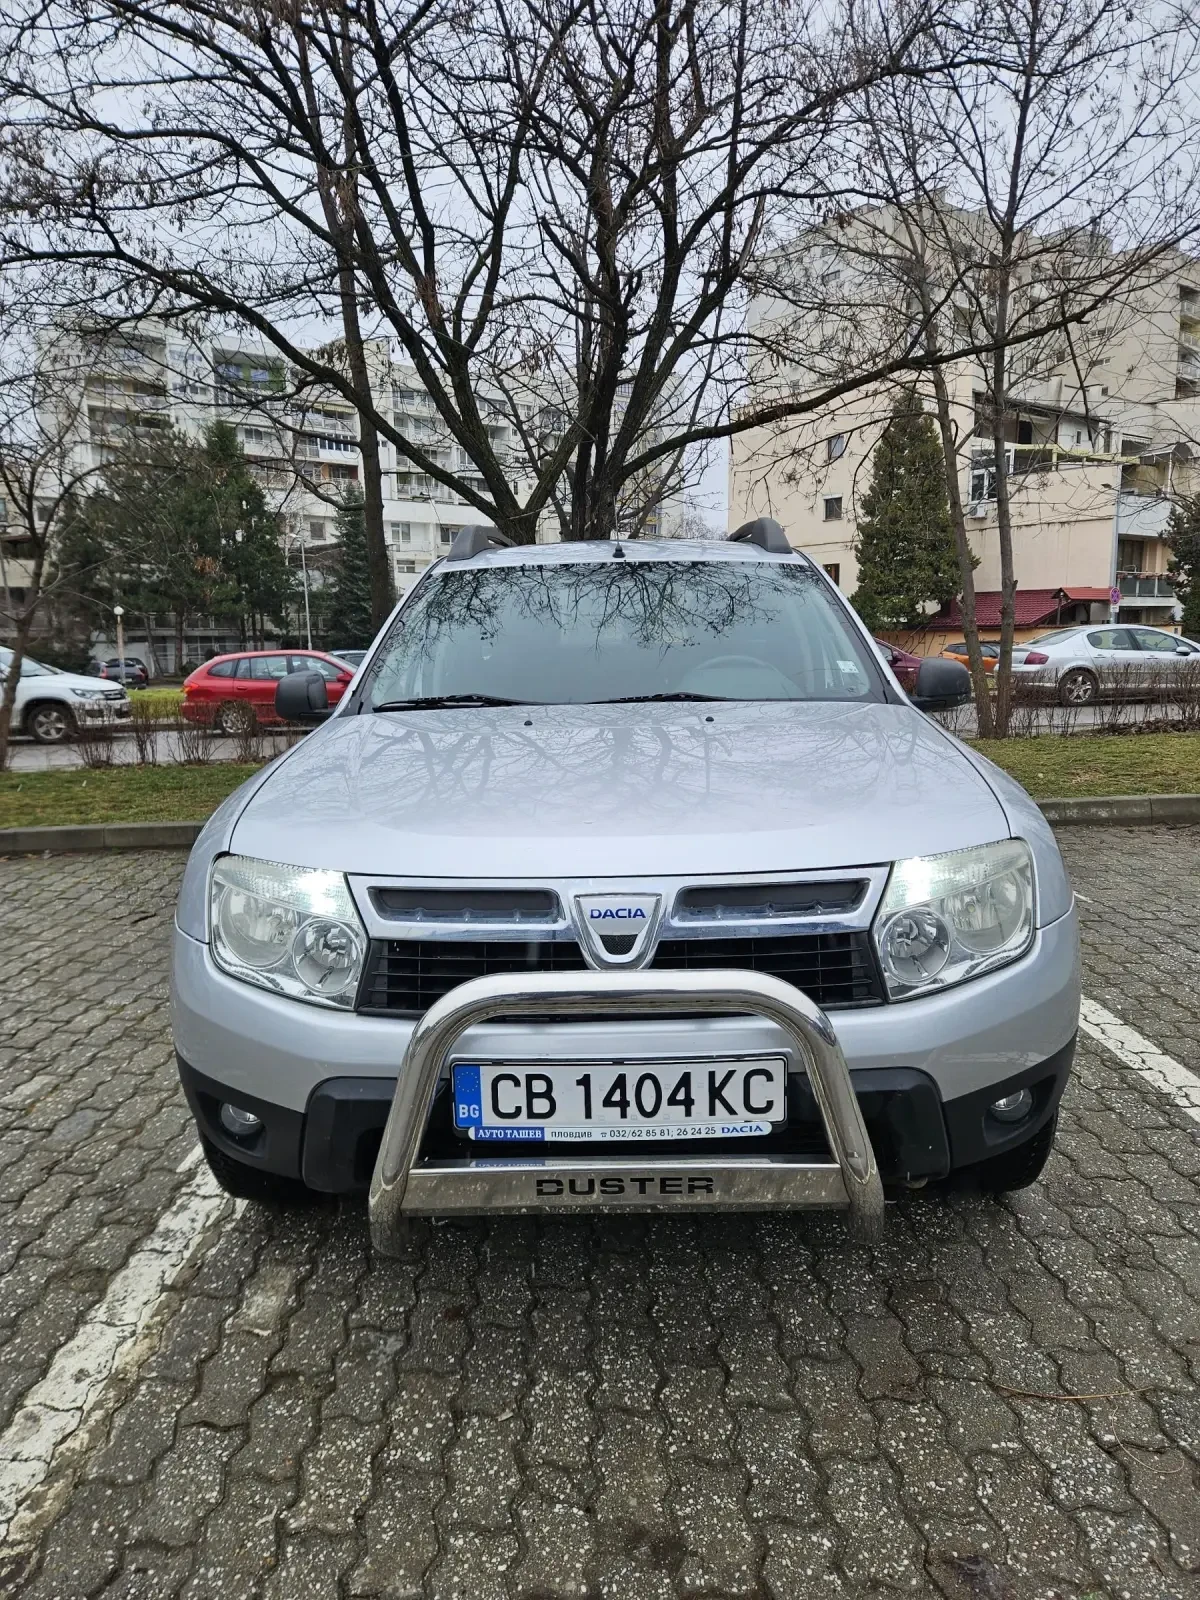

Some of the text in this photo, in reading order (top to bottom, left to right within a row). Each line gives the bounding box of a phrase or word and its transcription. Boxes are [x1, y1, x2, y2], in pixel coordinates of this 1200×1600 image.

[590, 908, 646, 919] DACIA
[491, 1068, 774, 1120] CB 1404 KC
[458, 1104, 480, 1119] BG
[478, 1128, 542, 1138] АУТО ТАШЕВ
[609, 1129, 643, 1138] 032/62
[645, 1128, 657, 1137] 85
[676, 1127, 689, 1136] 26
[691, 1127, 703, 1136] 24
[705, 1126, 717, 1135] 25
[721, 1124, 763, 1134] DACIA
[536, 1176, 714, 1197] DUSTER
